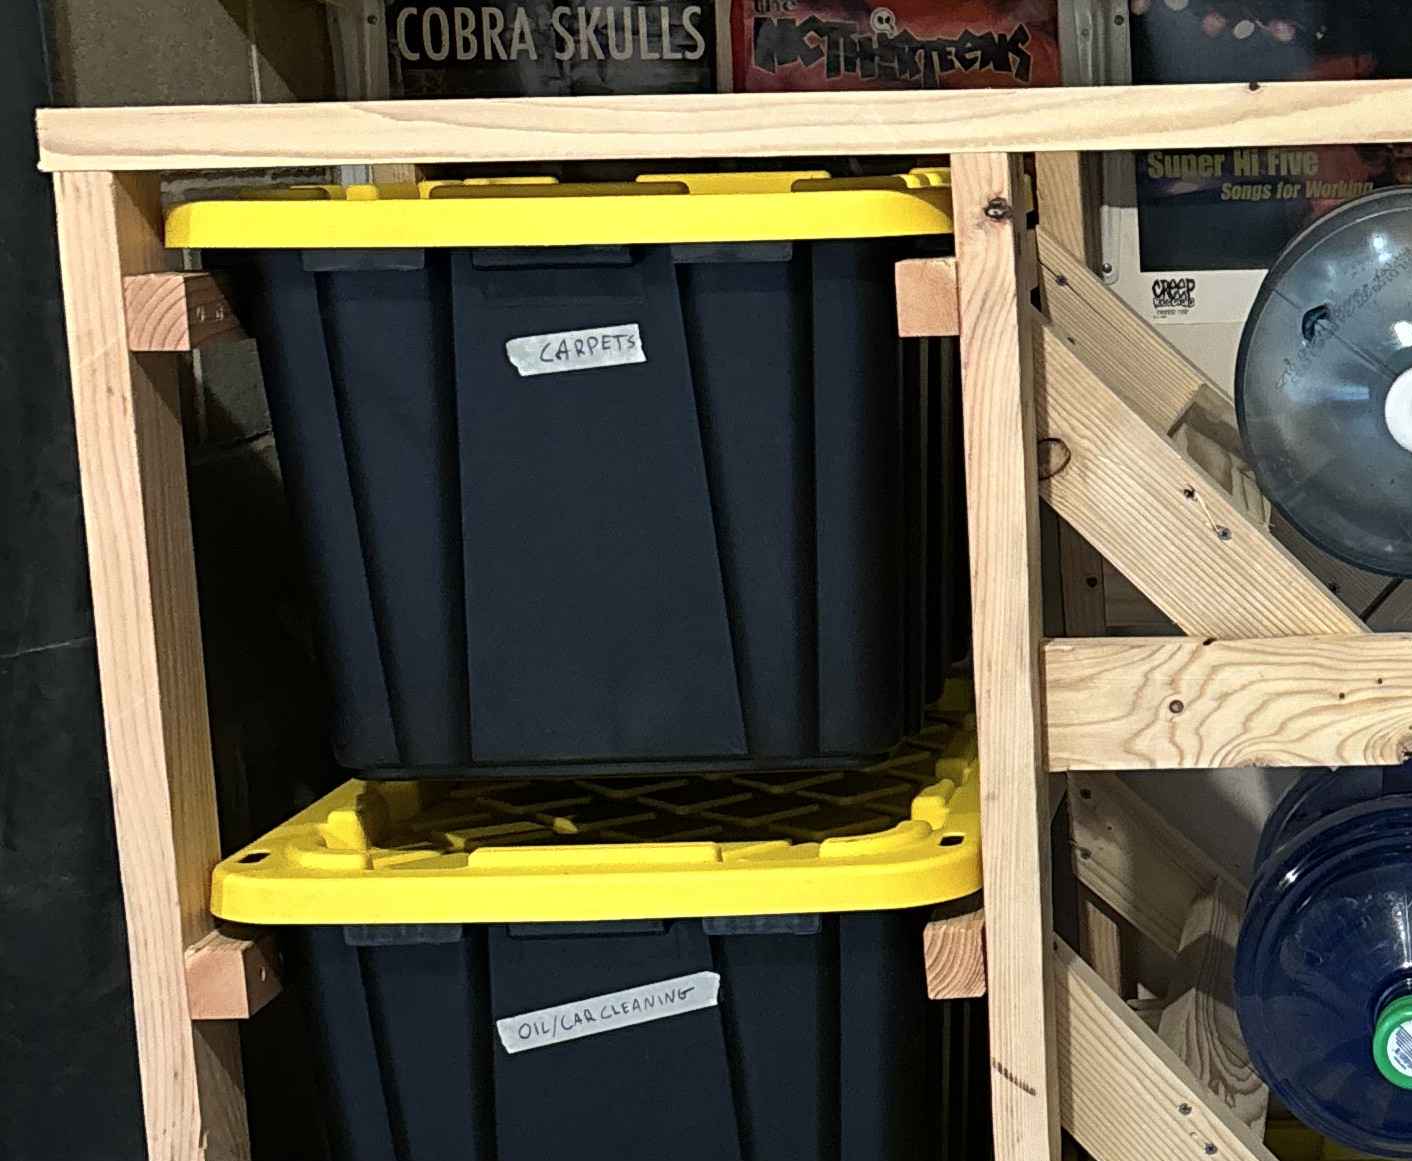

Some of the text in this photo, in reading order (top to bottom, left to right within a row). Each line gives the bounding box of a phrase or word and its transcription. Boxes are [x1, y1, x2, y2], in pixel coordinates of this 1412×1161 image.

[397, 6, 706, 61] COBRA SKULLS
[1148, 147, 1320, 181] Super Hi Five
[1221, 182, 1272, 201] Songs
[1275, 180, 1302, 200] for
[539, 334, 636, 363] CARPETS
[600, 986, 695, 1019] CLEANING
